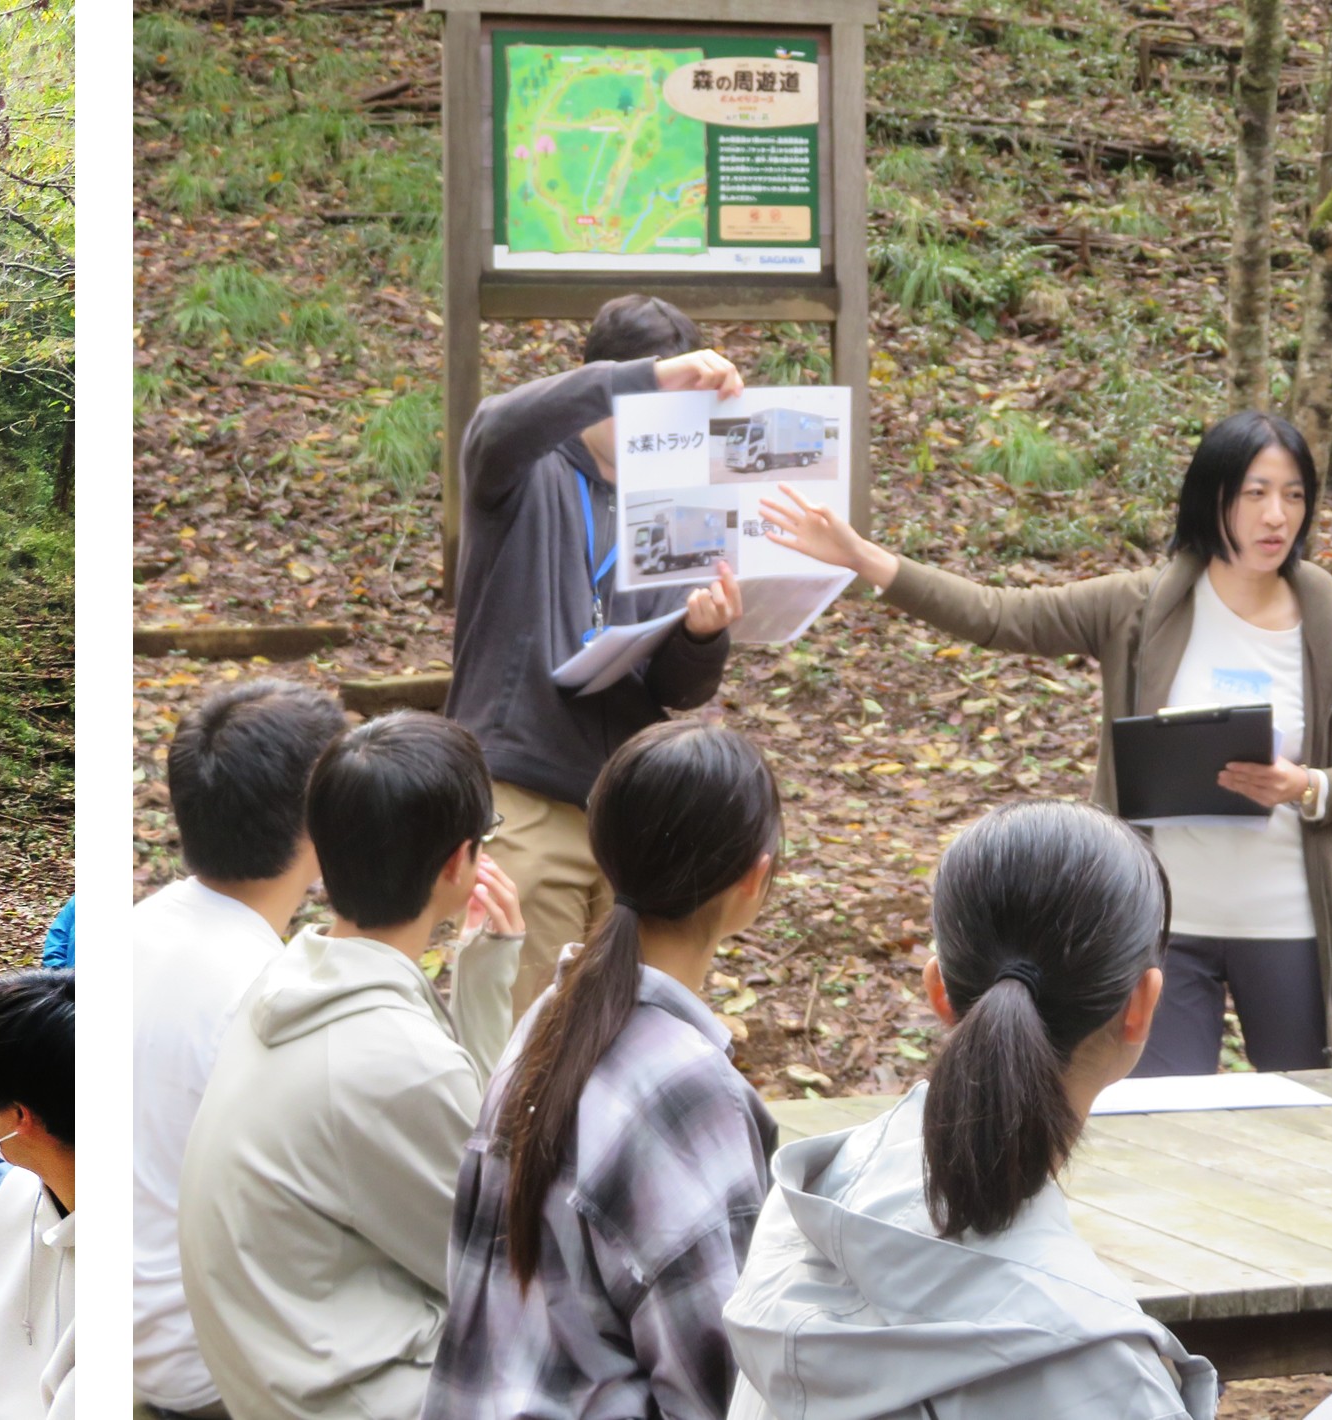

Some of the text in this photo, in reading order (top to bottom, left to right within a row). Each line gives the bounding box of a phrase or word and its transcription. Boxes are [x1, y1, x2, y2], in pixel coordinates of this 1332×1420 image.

[692, 69, 801, 93] 森の周遊道
[758, 255, 806, 265] SAGAWA
[627, 431, 705, 455] 水素トラック
